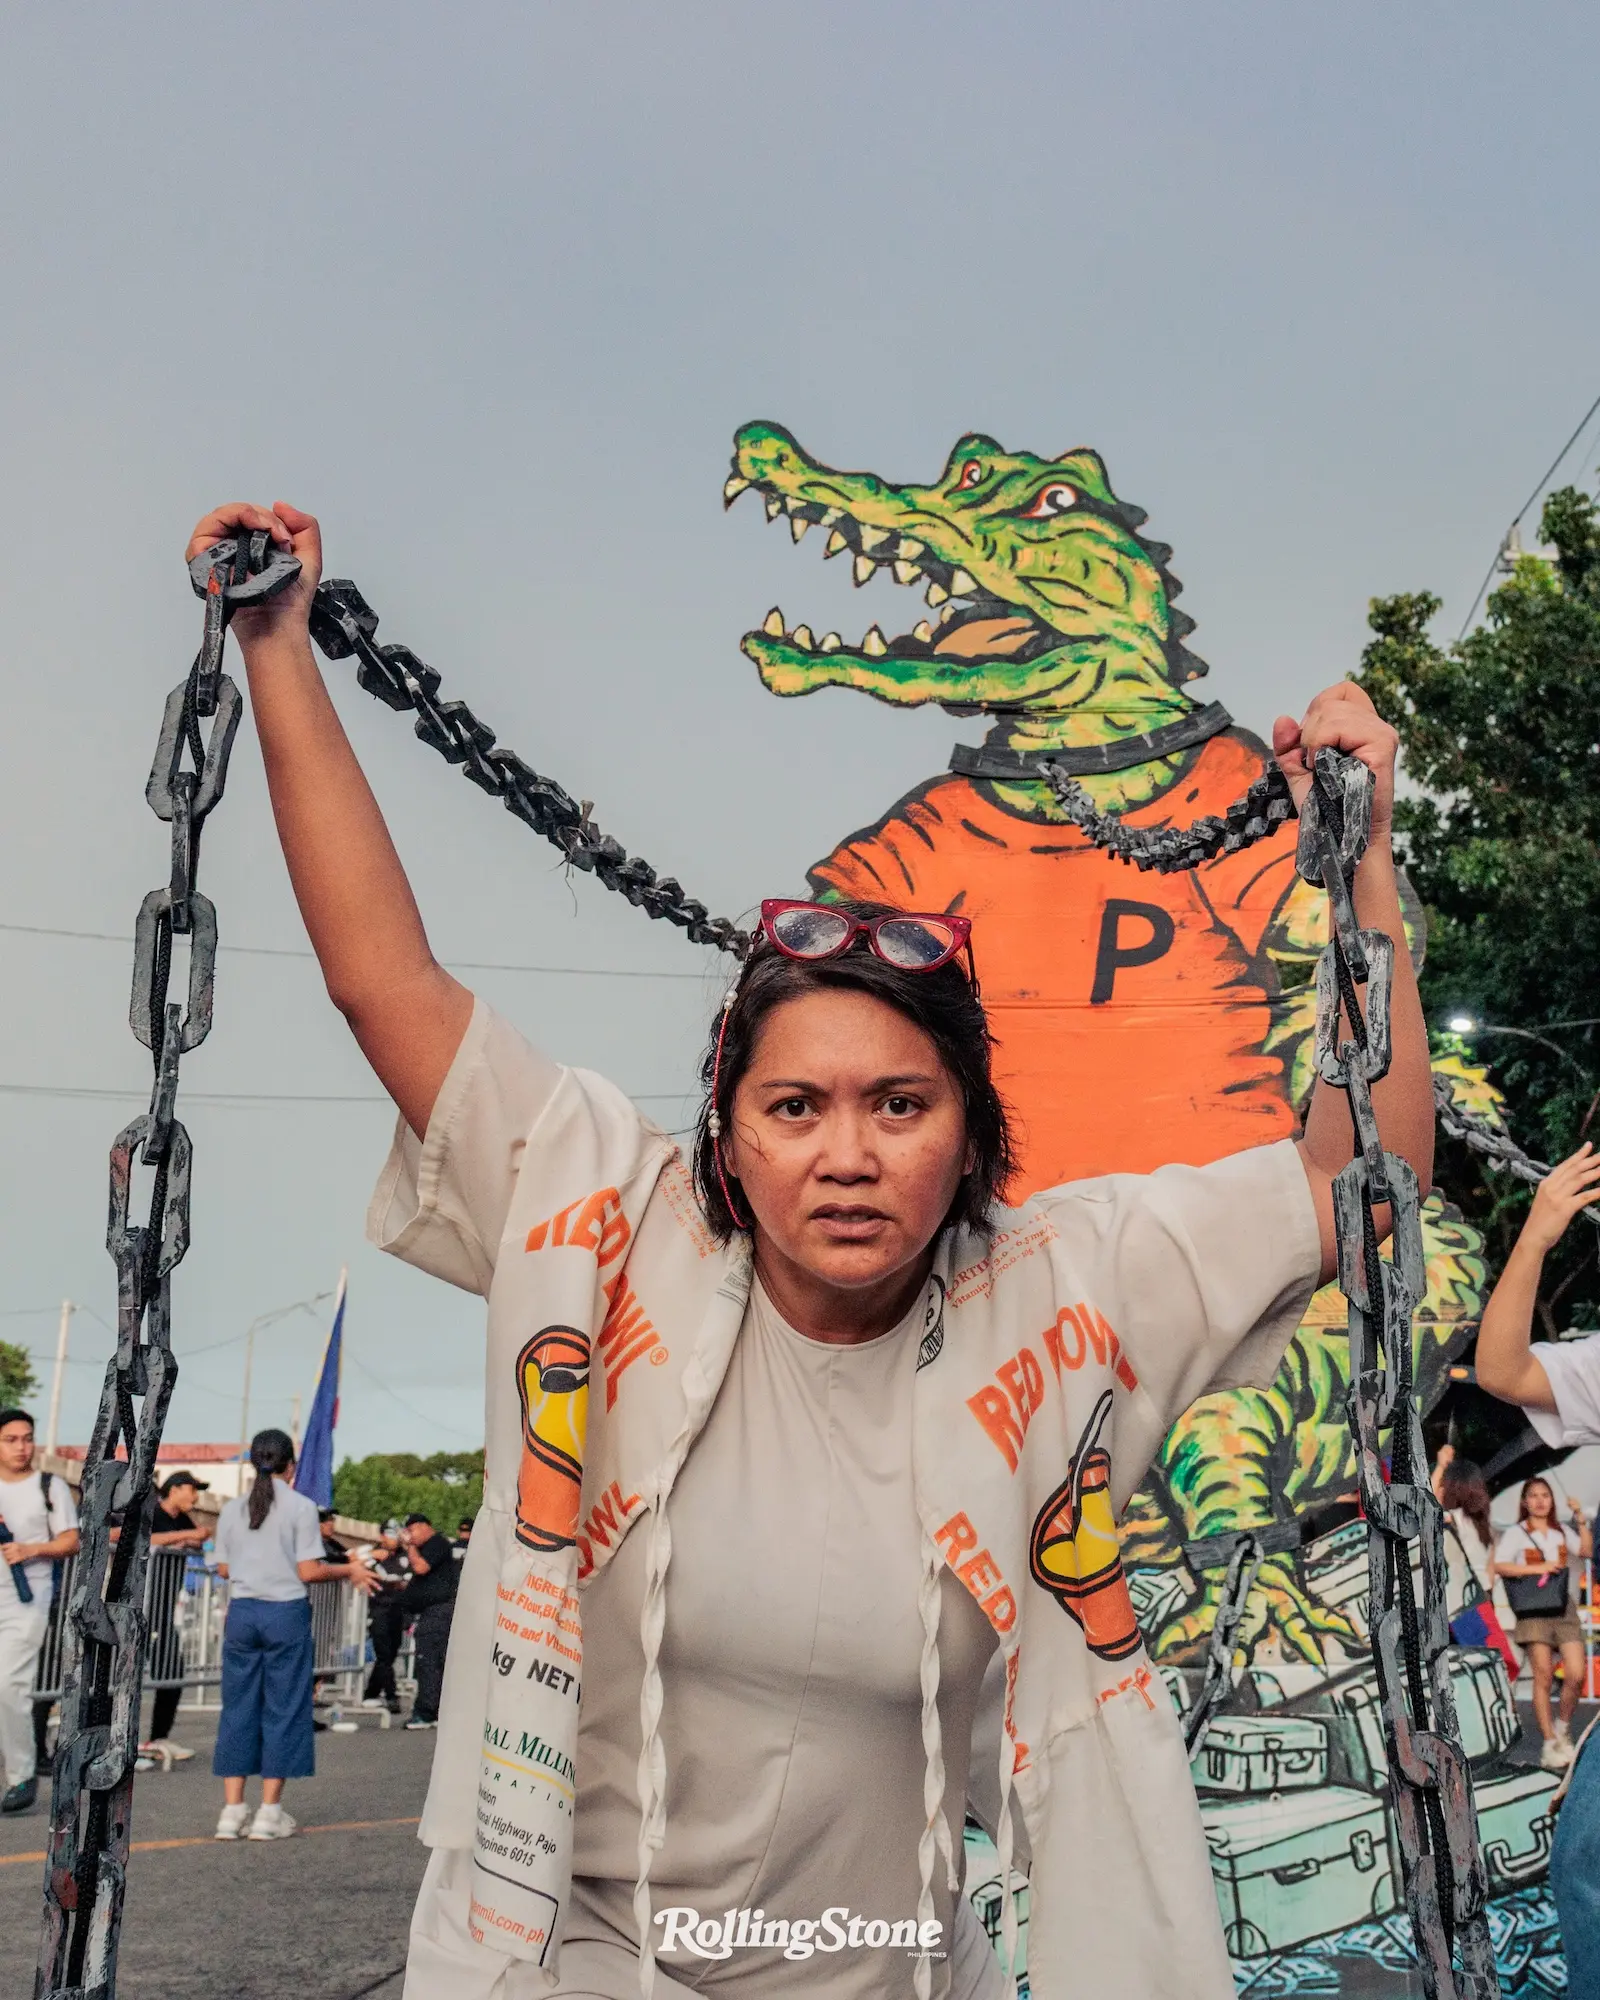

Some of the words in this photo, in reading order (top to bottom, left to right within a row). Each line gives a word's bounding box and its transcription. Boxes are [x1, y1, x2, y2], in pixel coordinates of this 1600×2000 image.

[1090, 898, 1175, 1005] P
[951, 1280, 989, 1309] Vitamin
[965, 1347, 1045, 1476] RED
[932, 1510, 1017, 1633] RED
[520, 1626, 544, 1643] and
[491, 1642, 517, 1678] kg
[526, 1658, 575, 1696] NET
[491, 1815, 534, 1847] Highway,
[535, 1833, 558, 1855] Pajo
[509, 1844, 536, 1868] 6015
